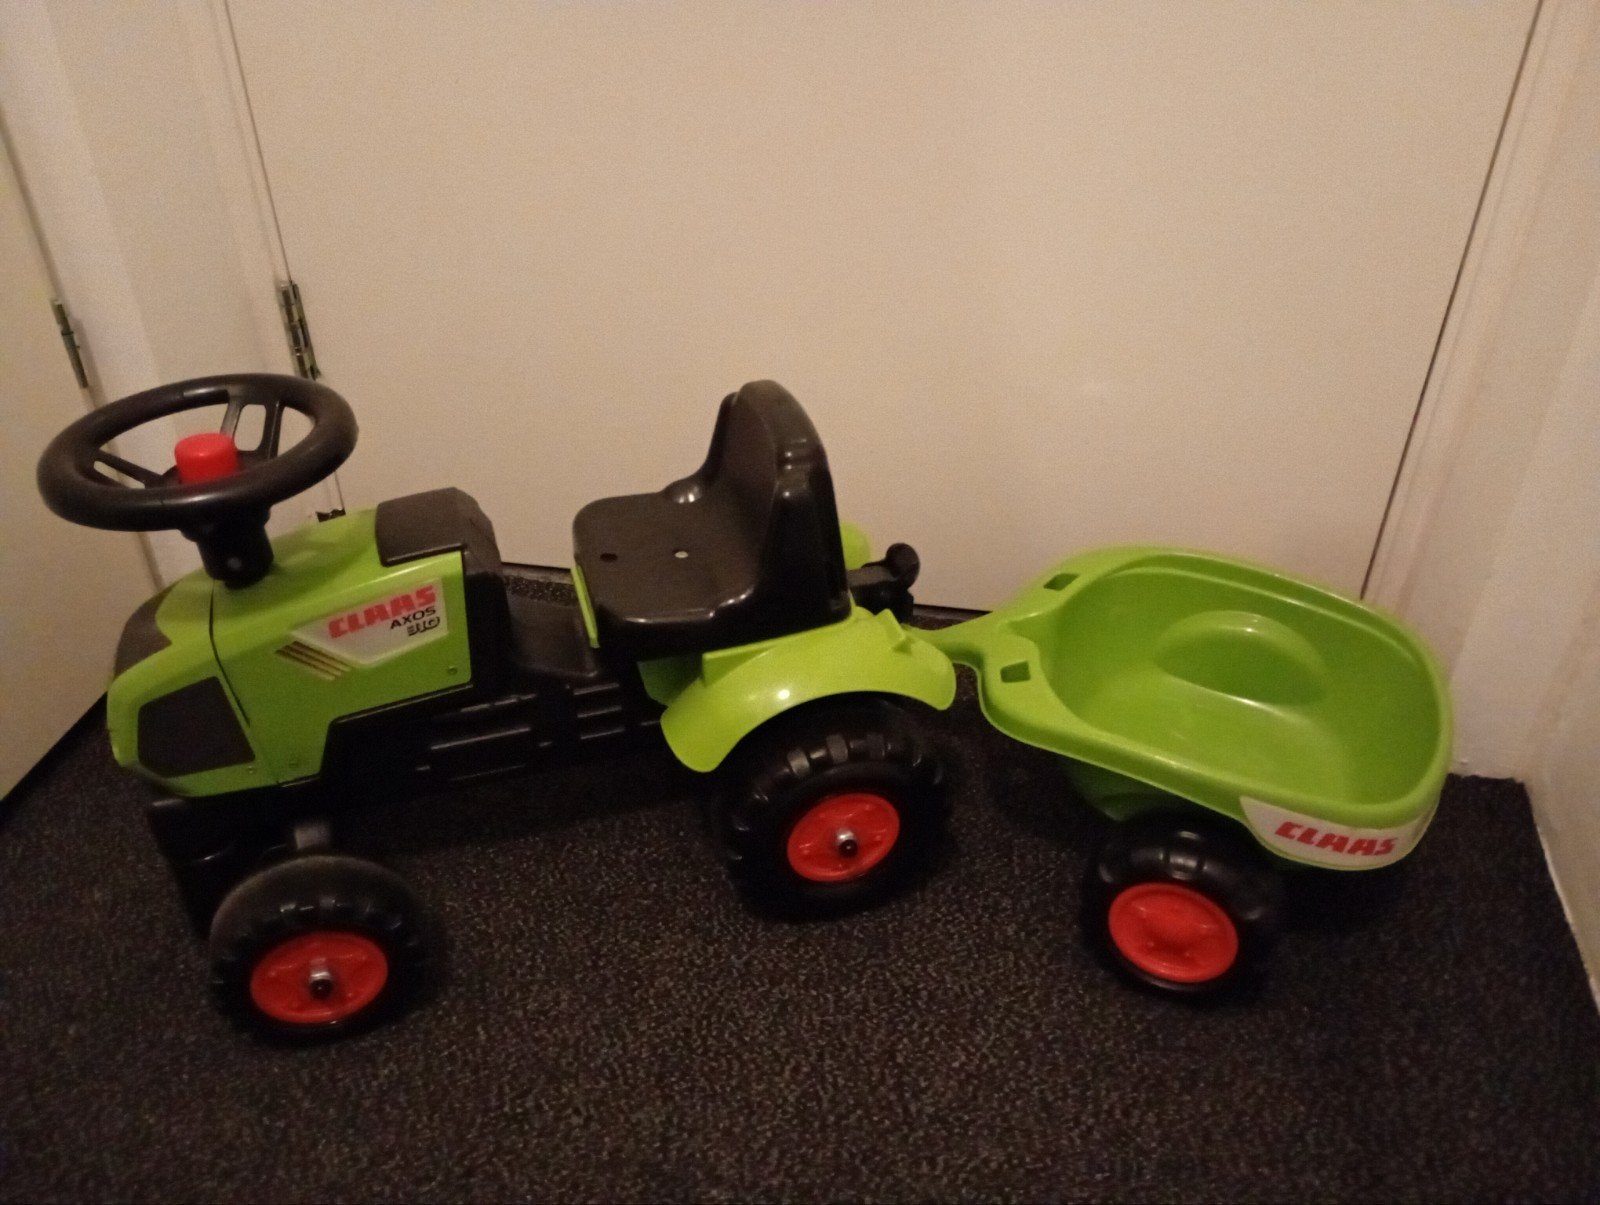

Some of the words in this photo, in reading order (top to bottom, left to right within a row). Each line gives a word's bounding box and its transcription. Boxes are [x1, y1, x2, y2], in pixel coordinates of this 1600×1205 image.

[328, 585, 436, 639] CLAAS
[390, 605, 437, 629] AXOS
[1274, 821, 1399, 855] CLAAS
